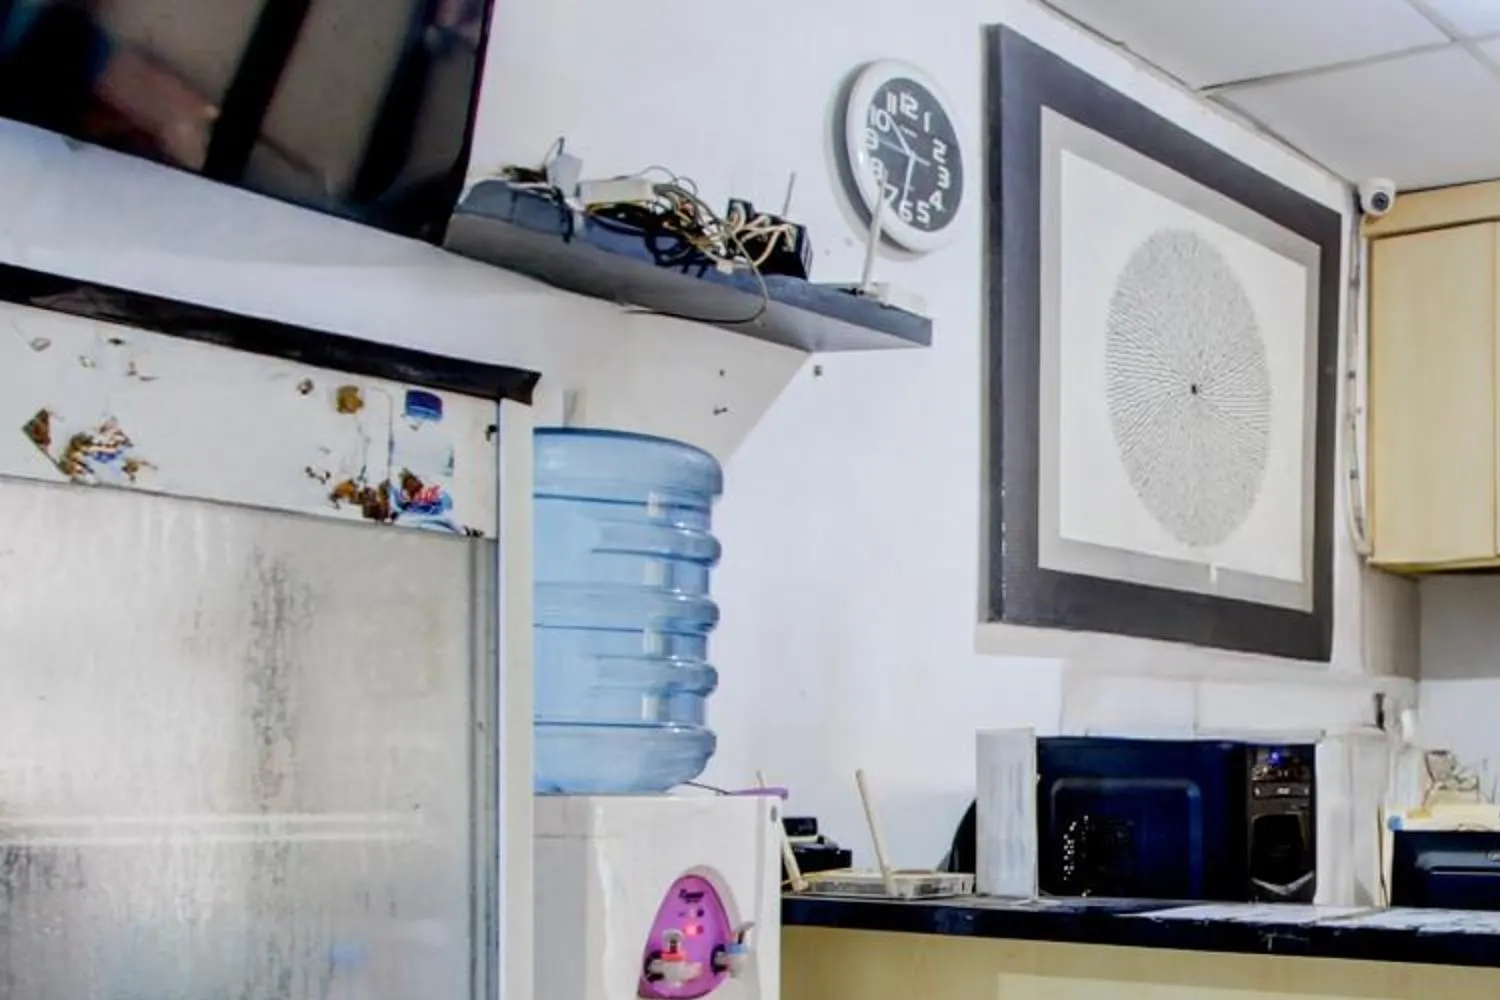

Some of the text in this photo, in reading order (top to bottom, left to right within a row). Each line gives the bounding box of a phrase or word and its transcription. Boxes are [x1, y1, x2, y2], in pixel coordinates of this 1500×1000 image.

[870, 105, 891, 132] 10
[923, 111, 931, 133] 1
[932, 138, 948, 164] 2
[936, 165, 951, 189] 3
[899, 200, 914, 222] 6
[916, 200, 931, 224] 5
[929, 189, 944, 213] 4
